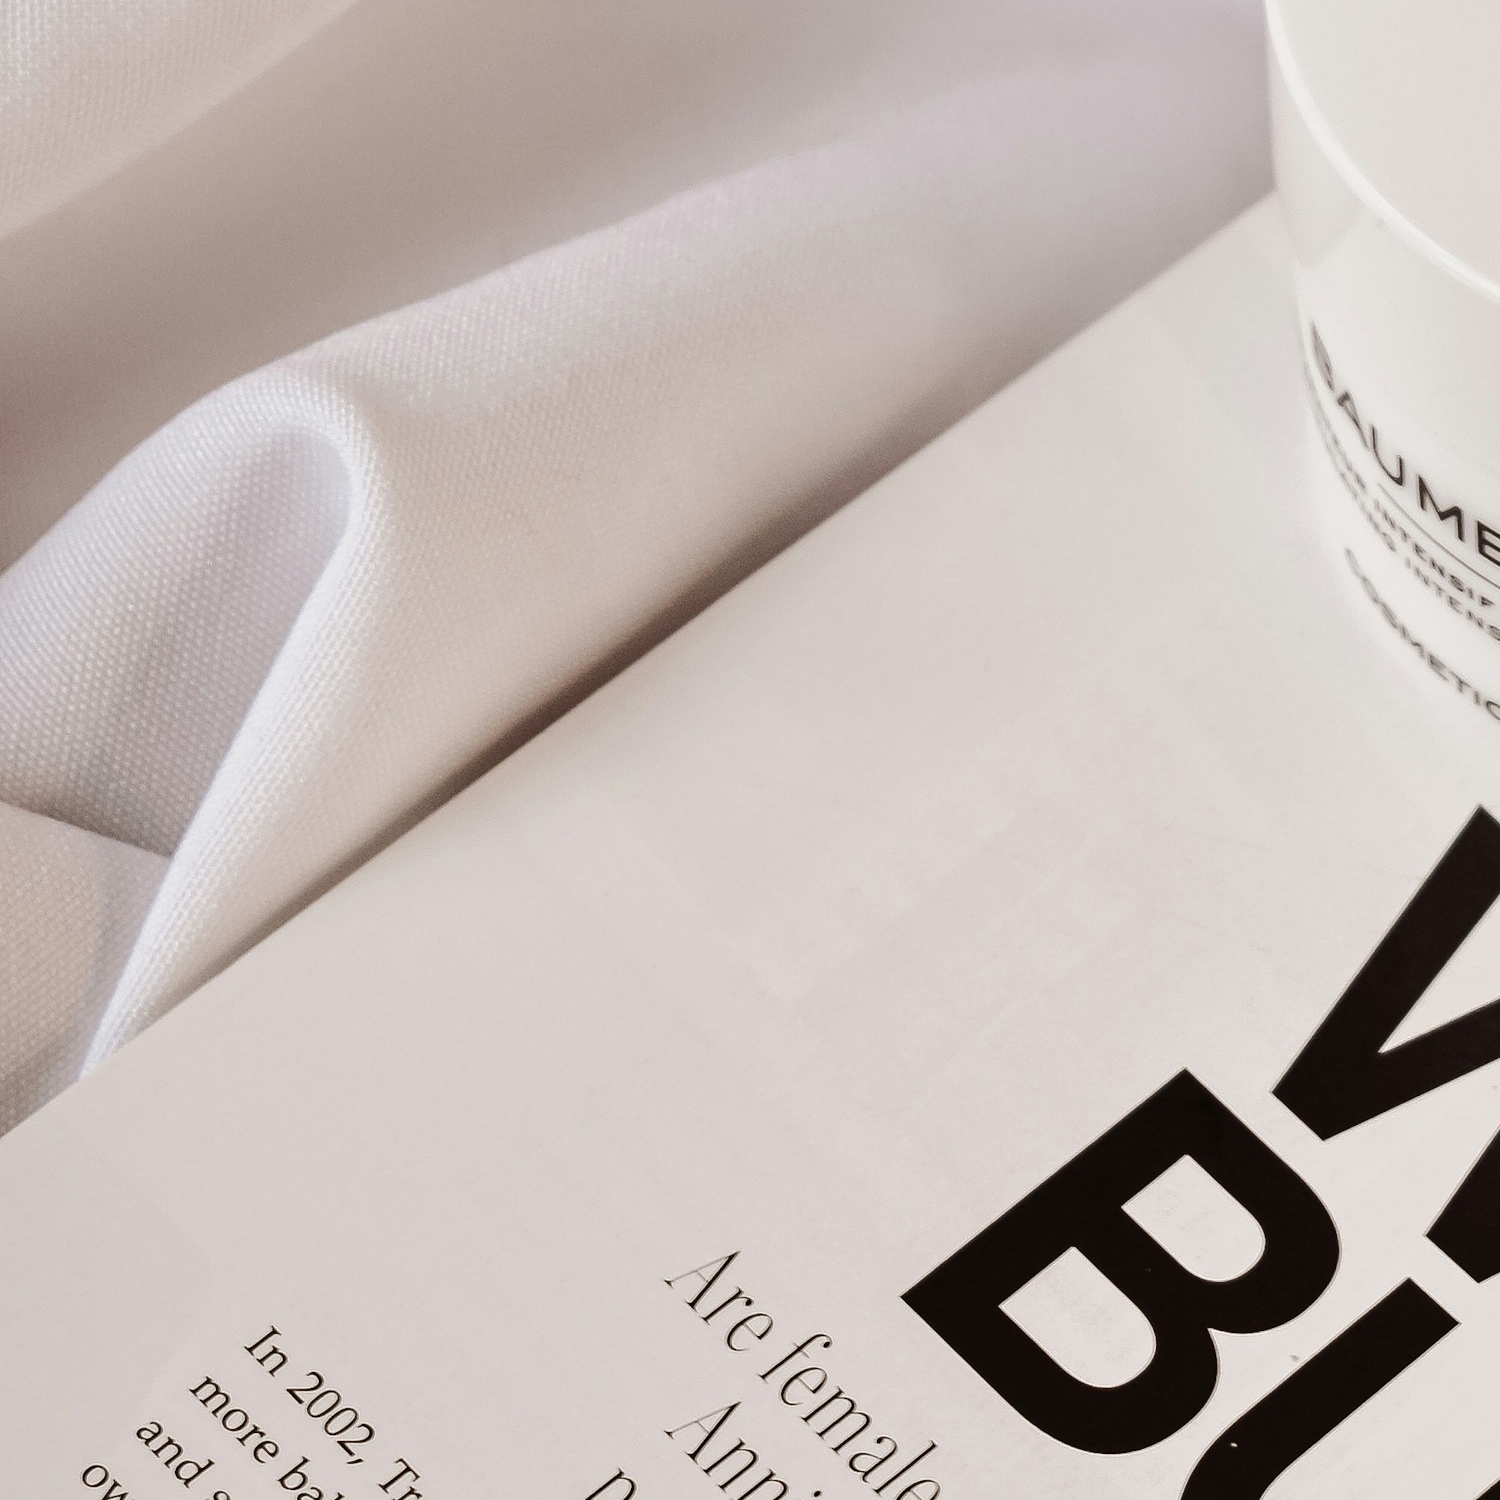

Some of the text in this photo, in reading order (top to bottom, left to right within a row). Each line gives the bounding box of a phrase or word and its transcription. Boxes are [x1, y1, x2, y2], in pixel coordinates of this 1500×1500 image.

[664, 1251, 773, 1351] Are
[188, 1376, 279, 1463] more
[244, 1325, 288, 1377] In
[286, 1372, 375, 1466] 2002,
[136, 1421, 215, 1489] and
